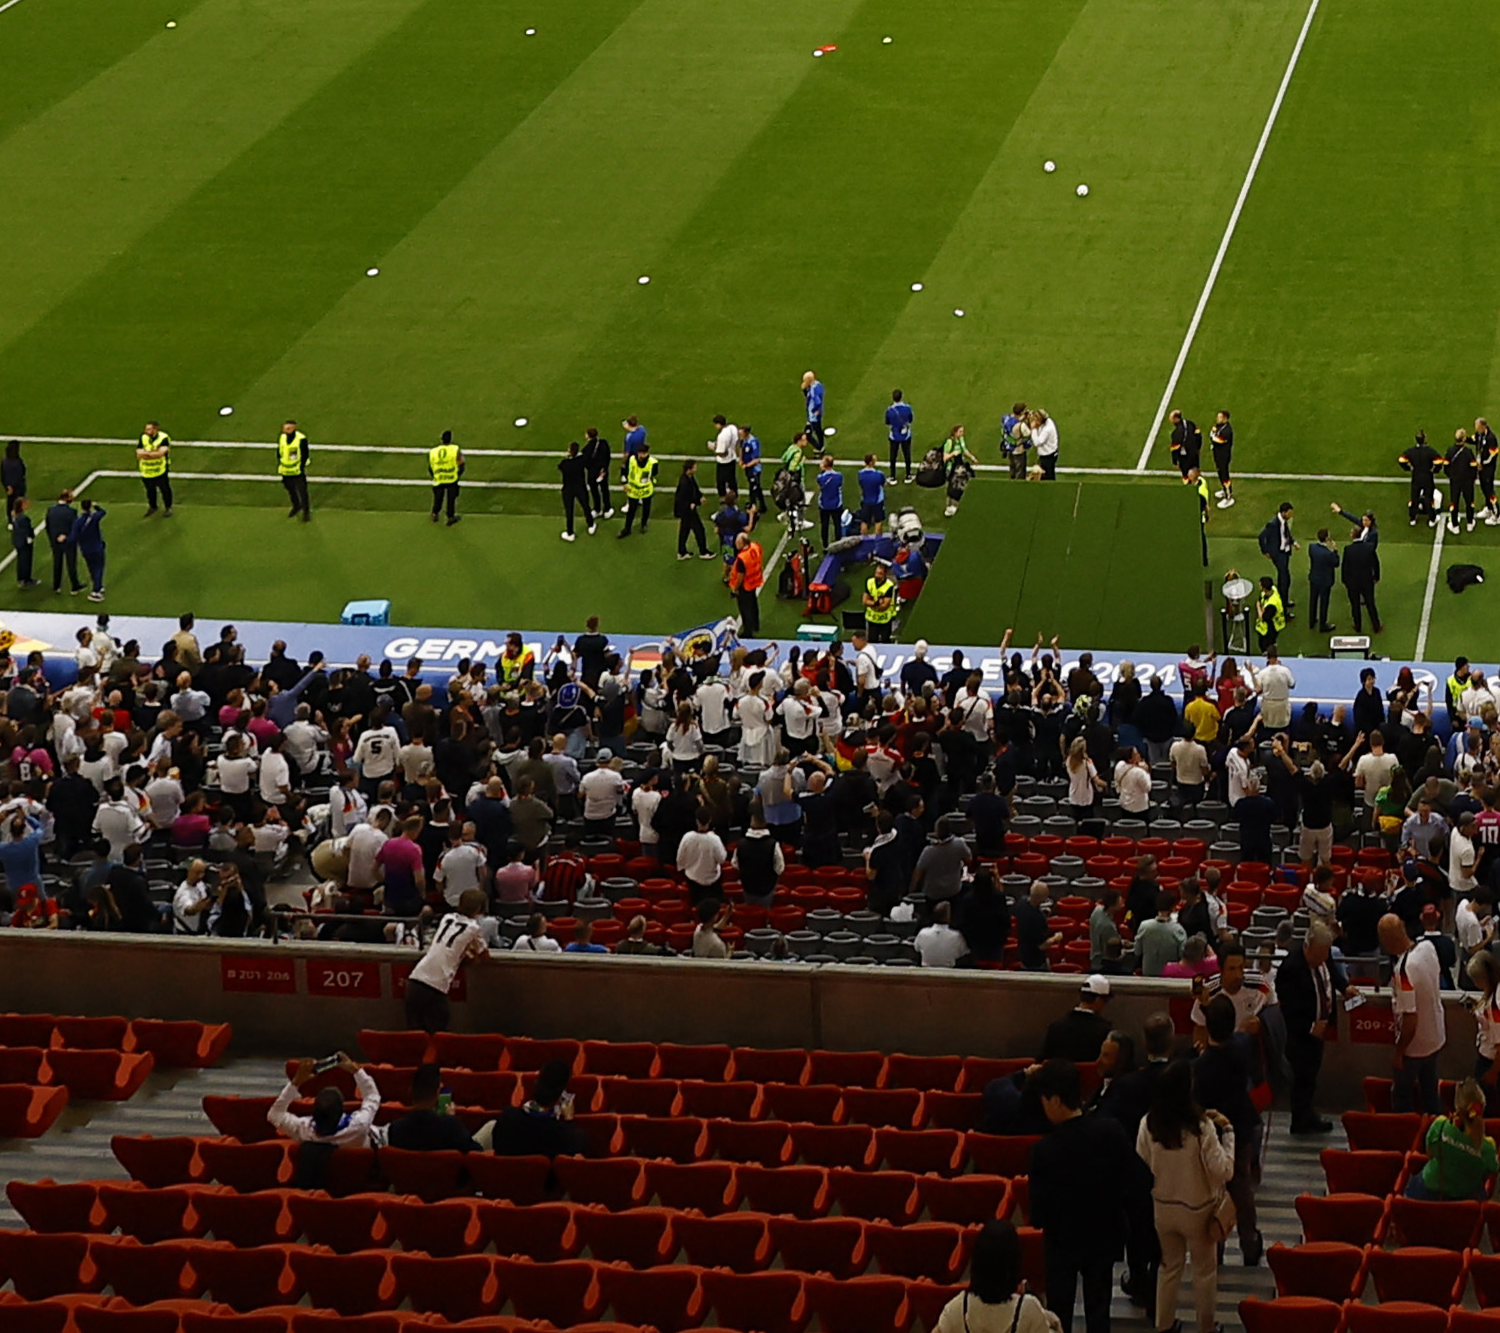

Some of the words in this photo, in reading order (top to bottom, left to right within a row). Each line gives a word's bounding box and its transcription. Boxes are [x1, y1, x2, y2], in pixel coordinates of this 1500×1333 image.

[370, 740, 383, 755] 5
[438, 915, 467, 947] 17
[321, 969, 365, 989] 207
